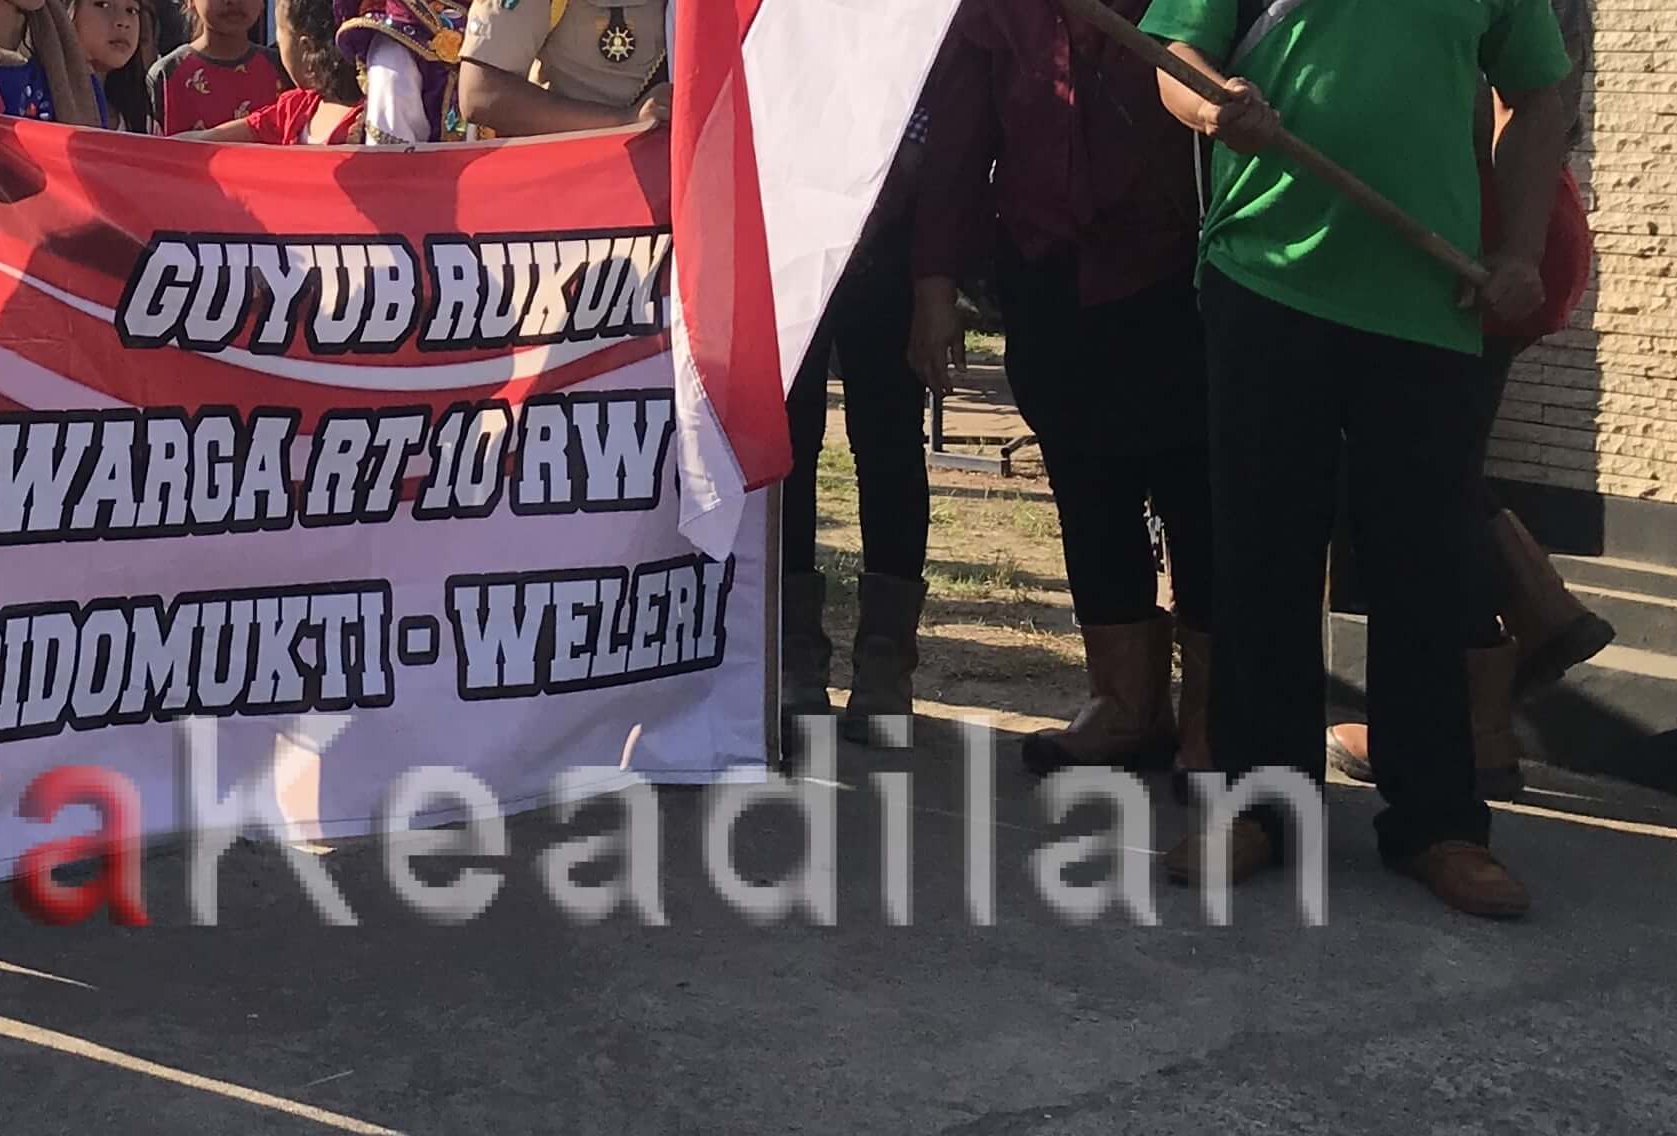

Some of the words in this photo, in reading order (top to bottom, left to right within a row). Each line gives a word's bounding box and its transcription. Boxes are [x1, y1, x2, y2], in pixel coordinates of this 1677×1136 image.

[117, 232, 420, 354] GUYUB
[420, 226, 672, 346] RUKUN
[299, 405, 431, 528] RT
[414, 396, 514, 519] 10
[511, 390, 675, 514] RW
[446, 556, 734, 701] WELERI
